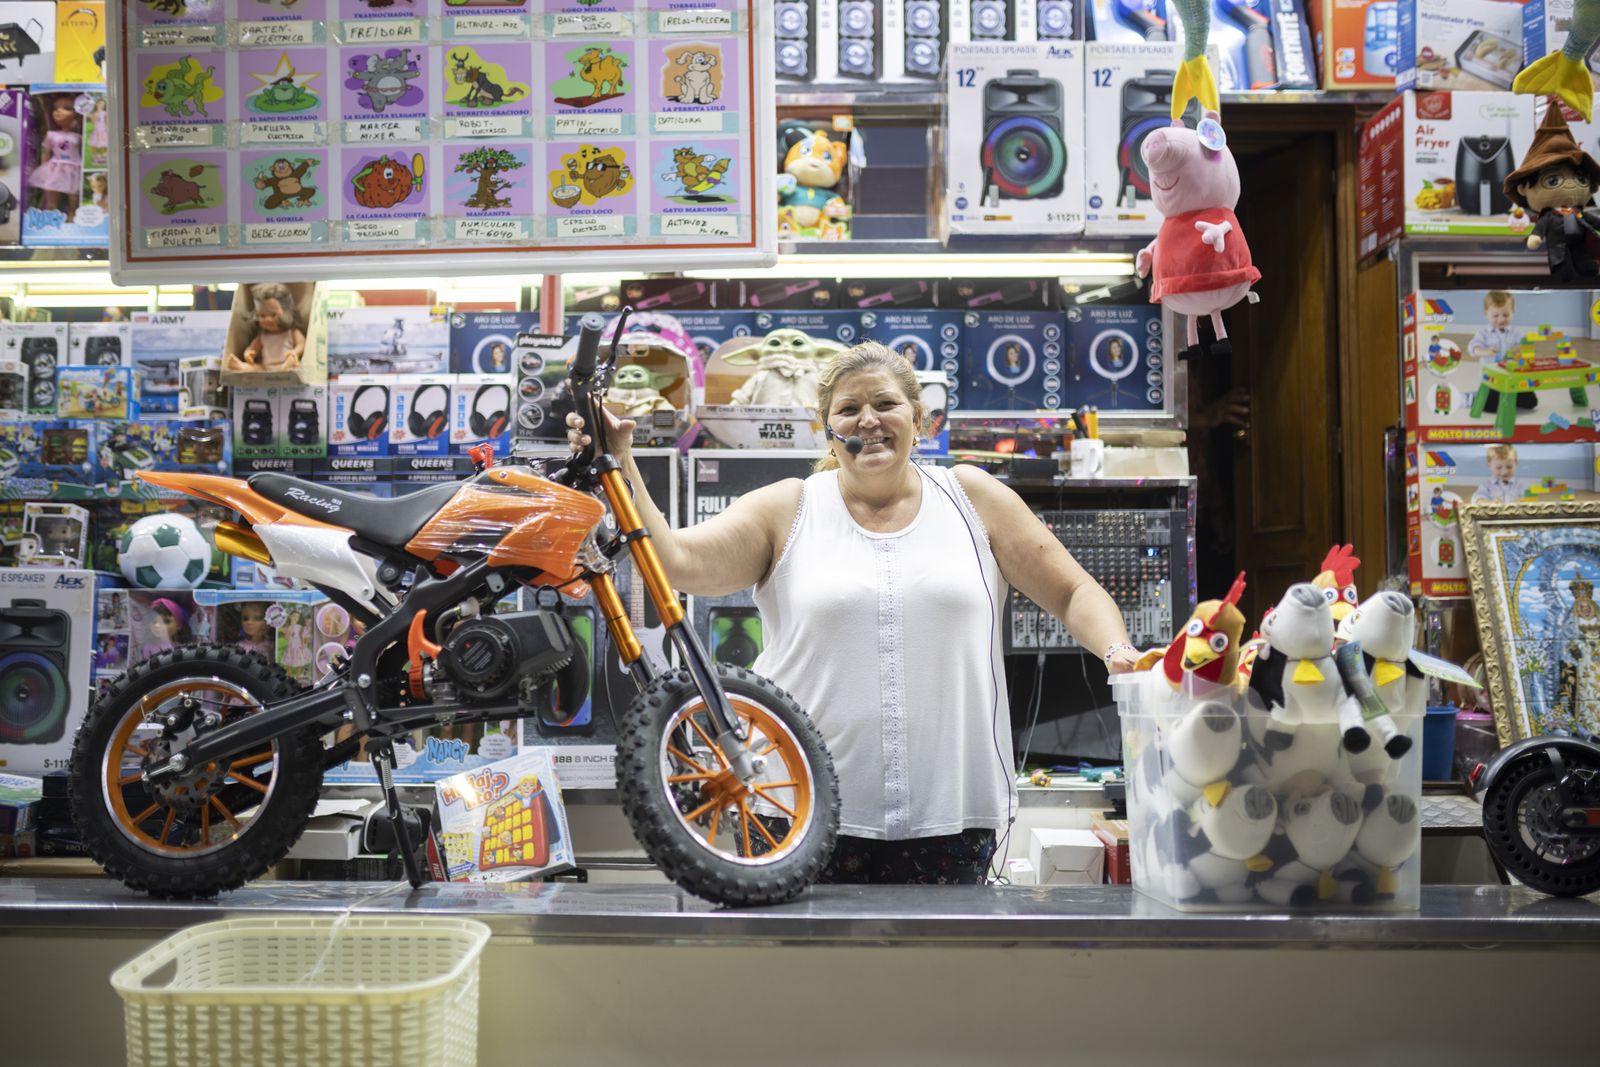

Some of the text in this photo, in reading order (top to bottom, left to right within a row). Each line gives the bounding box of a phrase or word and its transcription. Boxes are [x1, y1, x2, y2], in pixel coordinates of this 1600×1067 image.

[351, 27, 412, 38] FREIDORA
[954, 46, 999, 54] PORTABLE
[1416, 124, 1435, 135] Air
[360, 132, 396, 140] MIXER
[1416, 137, 1450, 151] Fryer
[1091, 310, 1133, 318] ARO DE LUZ
[152, 316, 185, 324] ARMY
[474, 316, 516, 324] ARO DE LUZ
[694, 316, 702, 325] DE
[704, 316, 720, 325] LUZ
[781, 316, 824, 324] ARO DE LUZ
[884, 316, 928, 324] ARO DE LUZ
[988, 316, 1030, 324] ARO DE LUZ
[518, 336, 562, 348] playmobil
[759, 423, 794, 432] STAR
[760, 432, 794, 440] WARS
[1428, 430, 1502, 439] MOLTO BLOCKS
[252, 459, 294, 470] QUEENS
[331, 460, 374, 470] QUEENS
[411, 458, 454, 469] QUEENS
[284, 488, 342, 514] Racing
[697, 496, 726, 513] FULL
[8, 574, 46, 584] SPEAKER
[1432, 582, 1466, 592] MOLTO
[426, 736, 469, 764] NANCY
